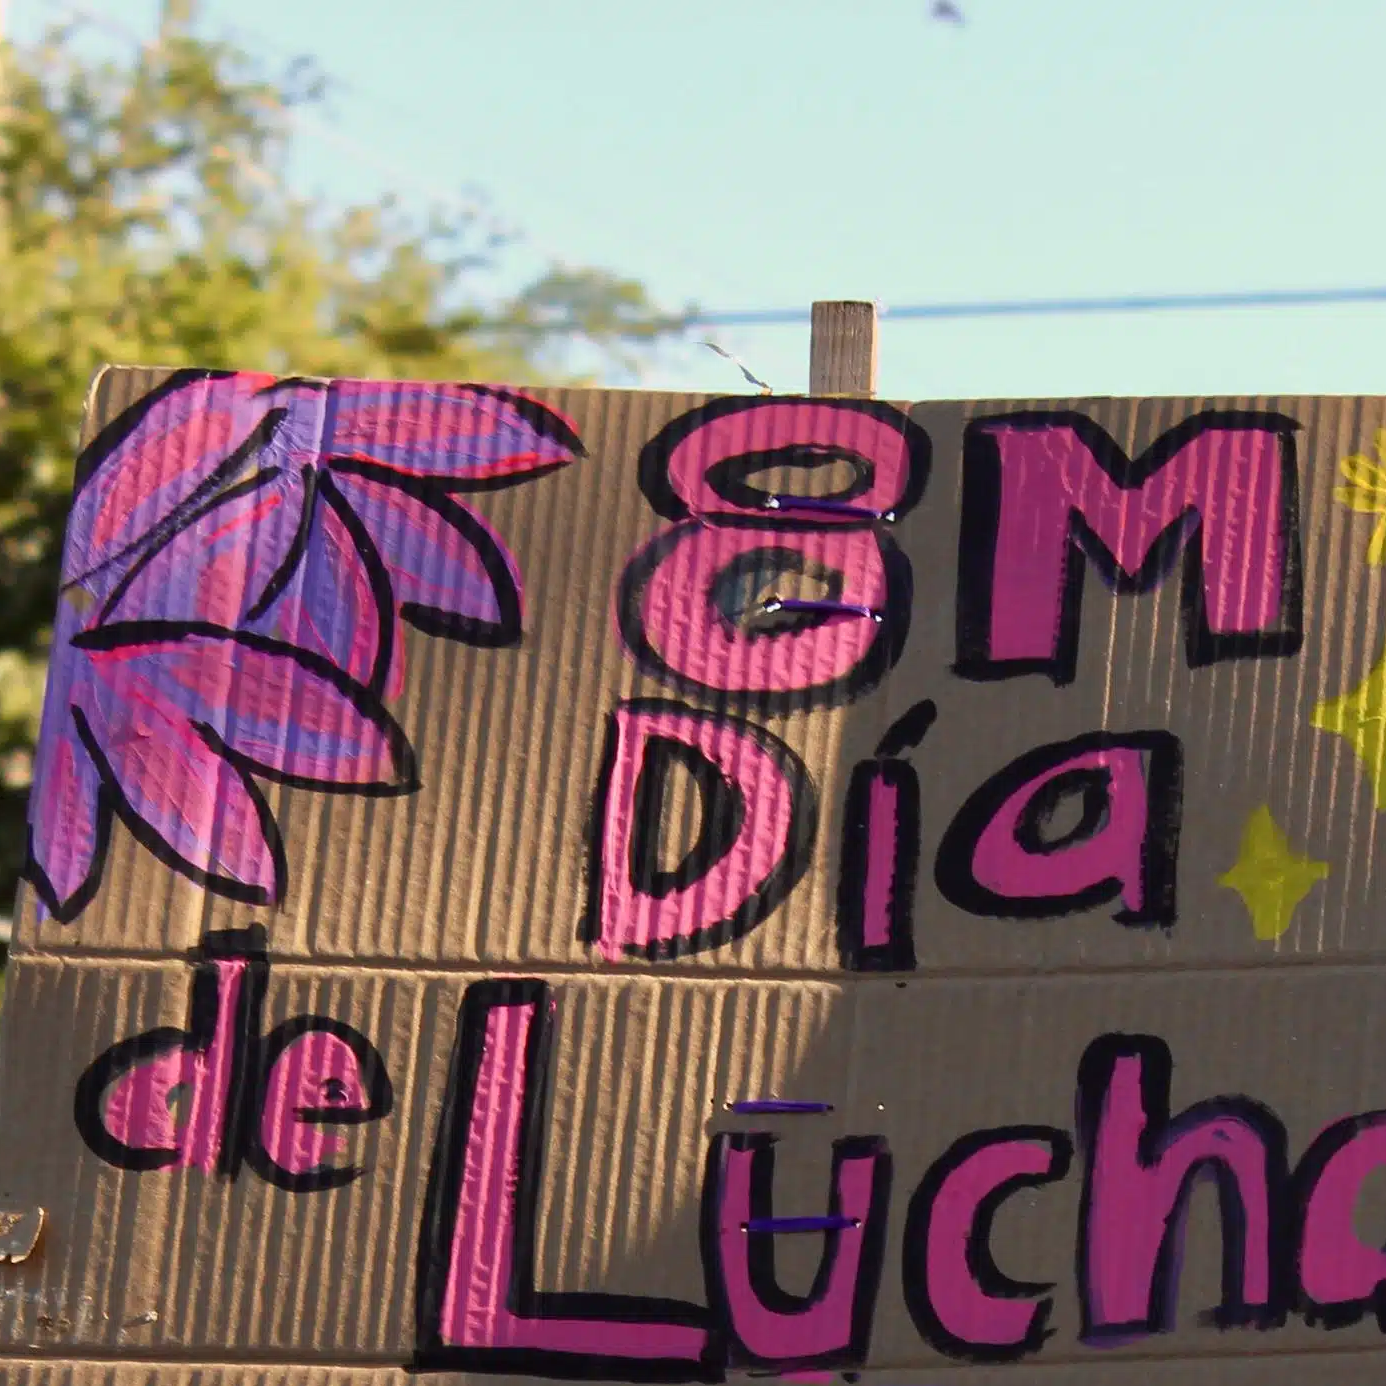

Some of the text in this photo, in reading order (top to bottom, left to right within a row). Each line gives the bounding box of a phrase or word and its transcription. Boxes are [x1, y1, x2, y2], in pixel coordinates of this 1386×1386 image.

[617, 395, 1305, 716] 8M
[585, 698, 1184, 972] Día
[75, 923, 394, 1194] de
